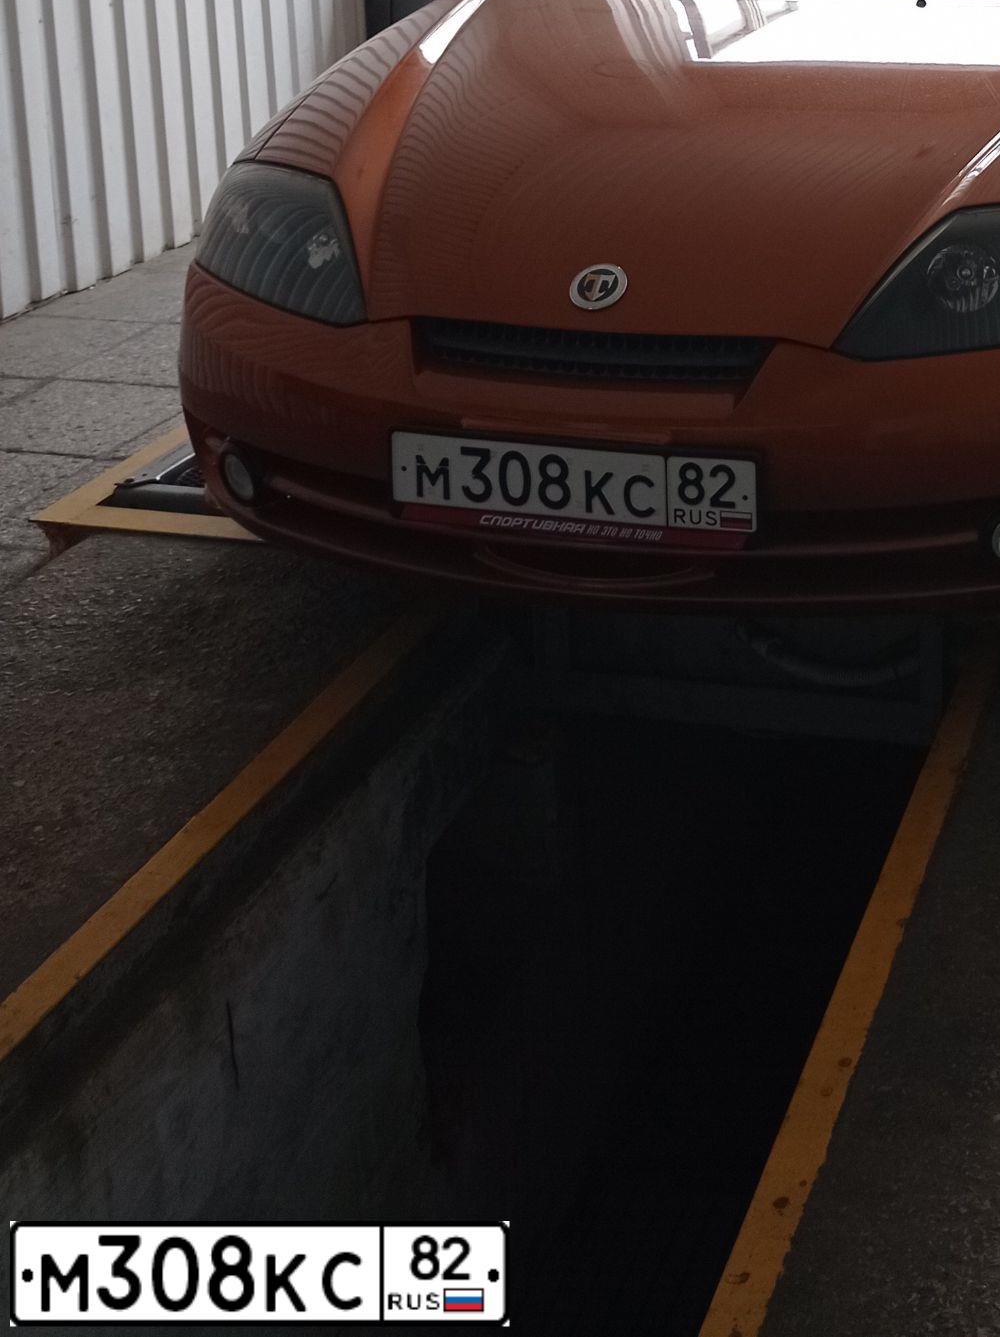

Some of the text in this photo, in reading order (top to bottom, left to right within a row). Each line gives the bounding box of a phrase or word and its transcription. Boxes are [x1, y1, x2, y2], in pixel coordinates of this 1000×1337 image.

[677, 461, 737, 509] 82
[479, 514, 587, 535] СПОРТИВНАЯ
[673, 508, 718, 527] RUS
